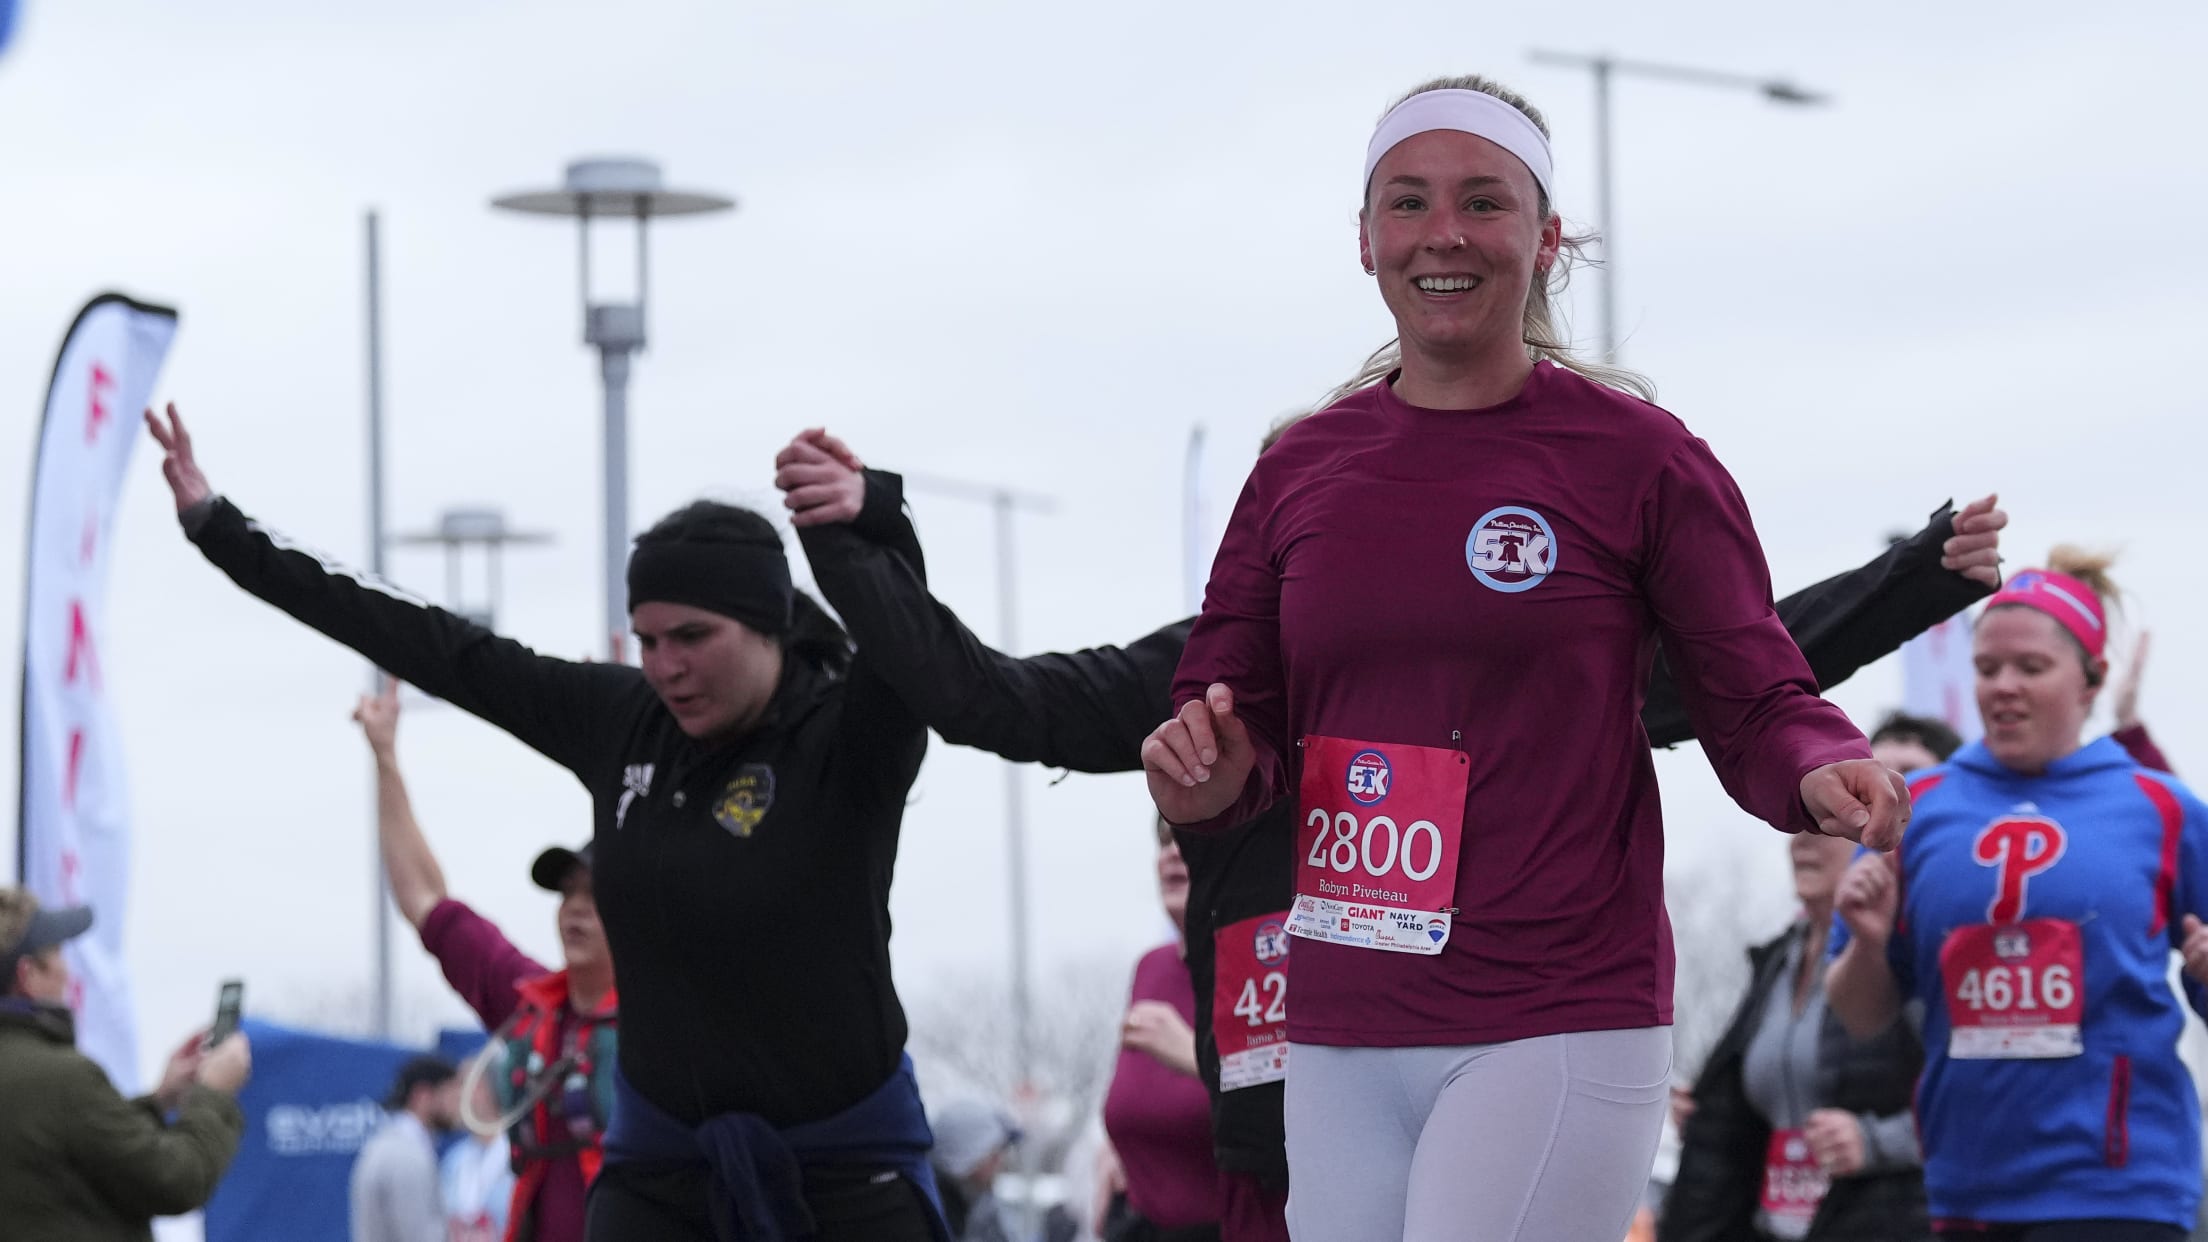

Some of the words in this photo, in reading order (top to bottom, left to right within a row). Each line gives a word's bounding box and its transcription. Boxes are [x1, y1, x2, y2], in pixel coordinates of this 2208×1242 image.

[1471, 529, 1550, 576] 5K
[1348, 765, 1389, 796] 5K
[1306, 807, 1443, 882] 2800
[1973, 815, 2067, 925] P
[1318, 878, 1349, 897] Robyn
[1352, 883, 1408, 903] Piveteau
[1348, 907, 1385, 920] GIANT
[1351, 923, 1375, 932] TOYOTA
[1389, 912, 1416, 921] NAVY
[1396, 921, 1423, 931] YARD
[1956, 964, 2075, 1011] 4616
